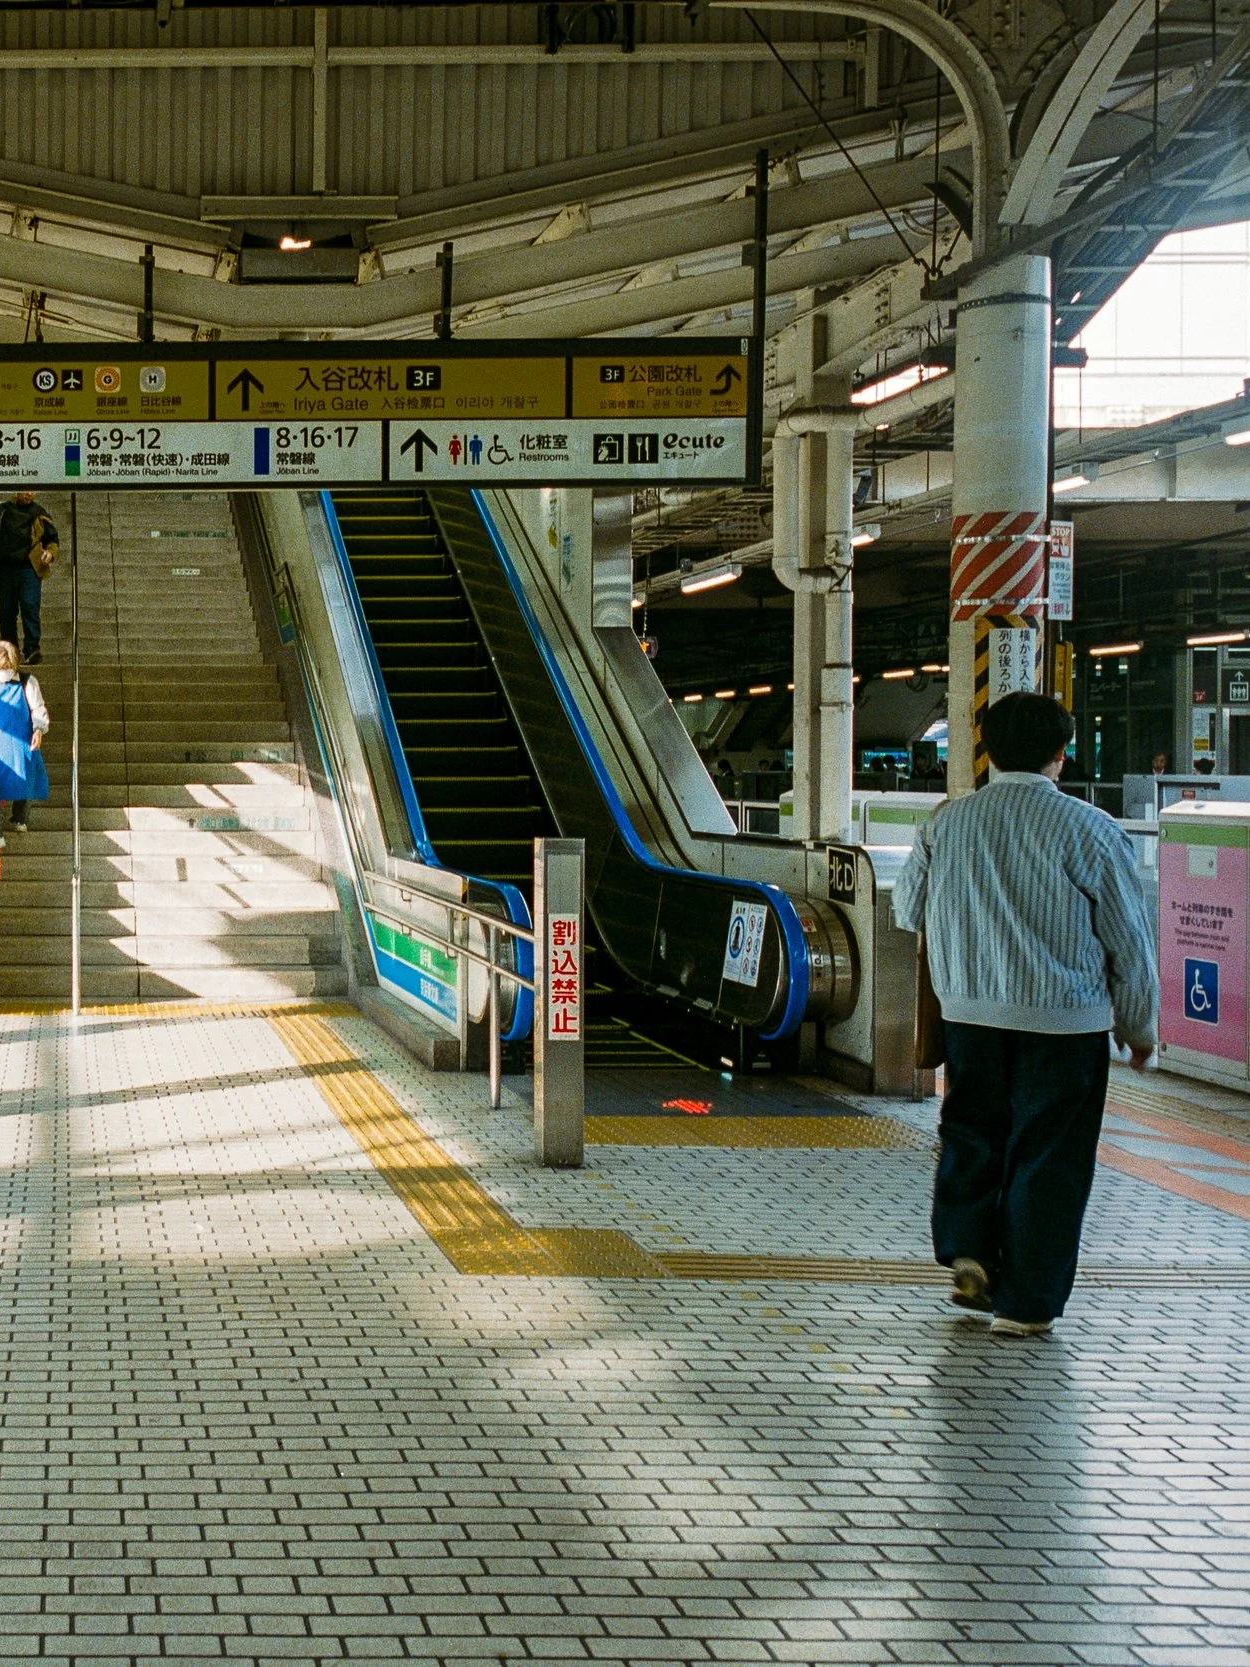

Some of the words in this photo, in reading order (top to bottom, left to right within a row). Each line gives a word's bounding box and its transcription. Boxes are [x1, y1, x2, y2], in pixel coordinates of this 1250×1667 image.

[39, 374, 52, 386] KS
[103, 375, 112, 384] G
[148, 375, 157, 384] H
[294, 366, 399, 392] 入谷改札
[413, 370, 435, 387] 3F
[605, 368, 620, 380] 3F
[629, 364, 703, 383] 公園改札
[646, 386, 672, 396] Park
[675, 386, 703, 396] Gate
[294, 398, 326, 415] Iriya
[331, 398, 369, 411] Gate
[520, 434, 568, 450] 化粧室
[662, 432, 726, 449] ecute
[276, 452, 316, 466] 常磐線
[519, 453, 569, 462] Restrooms
[662, 452, 700, 460] エキュート
[22, 469, 39, 477] Line
[201, 468, 218, 476] Line
[1051, 526, 1070, 537] STOP
[998, 630, 1012, 693] 列の後ろか
[829, 856, 854, 891] 北D
[551, 920, 578, 1034] 割込禁止
